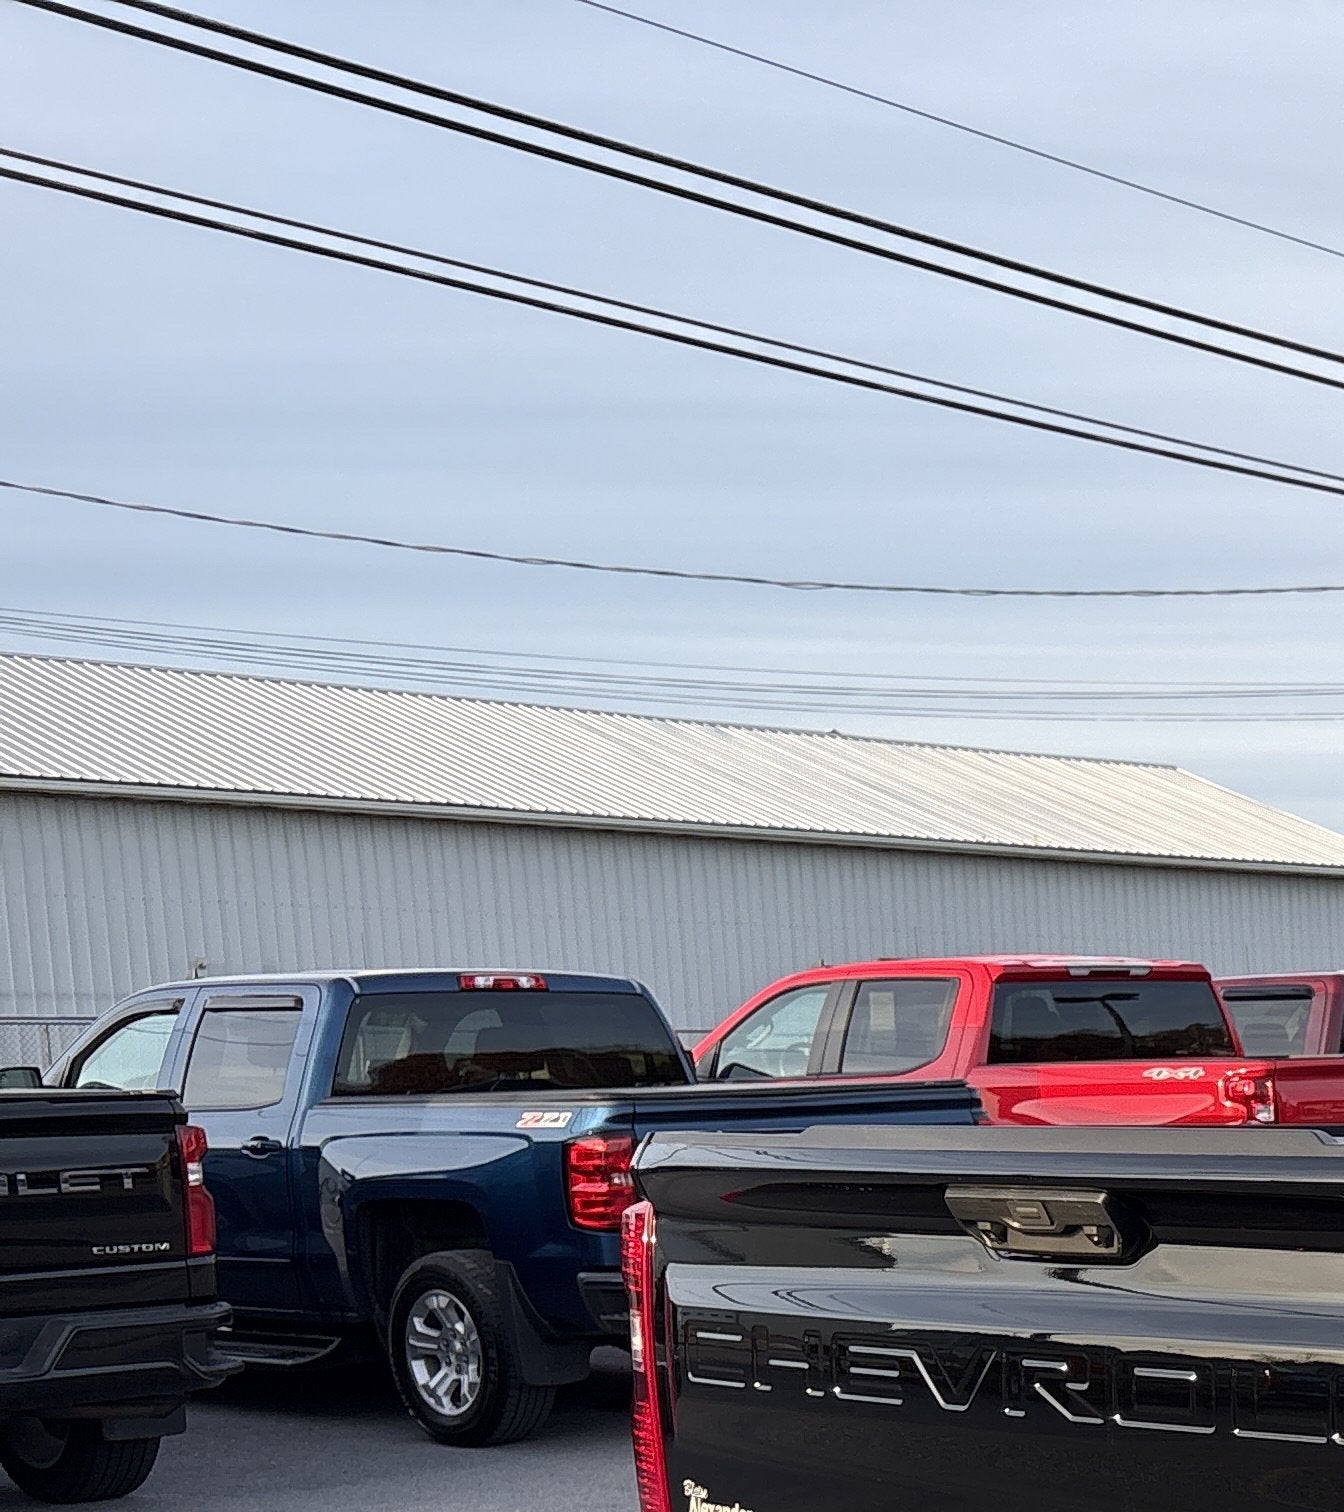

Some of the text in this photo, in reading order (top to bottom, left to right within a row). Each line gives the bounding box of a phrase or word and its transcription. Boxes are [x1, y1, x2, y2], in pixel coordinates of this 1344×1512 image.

[516, 1112, 572, 1128] Z71
[0, 1168, 149, 1196] LET
[92, 1242, 170, 1255] CUSTOM
